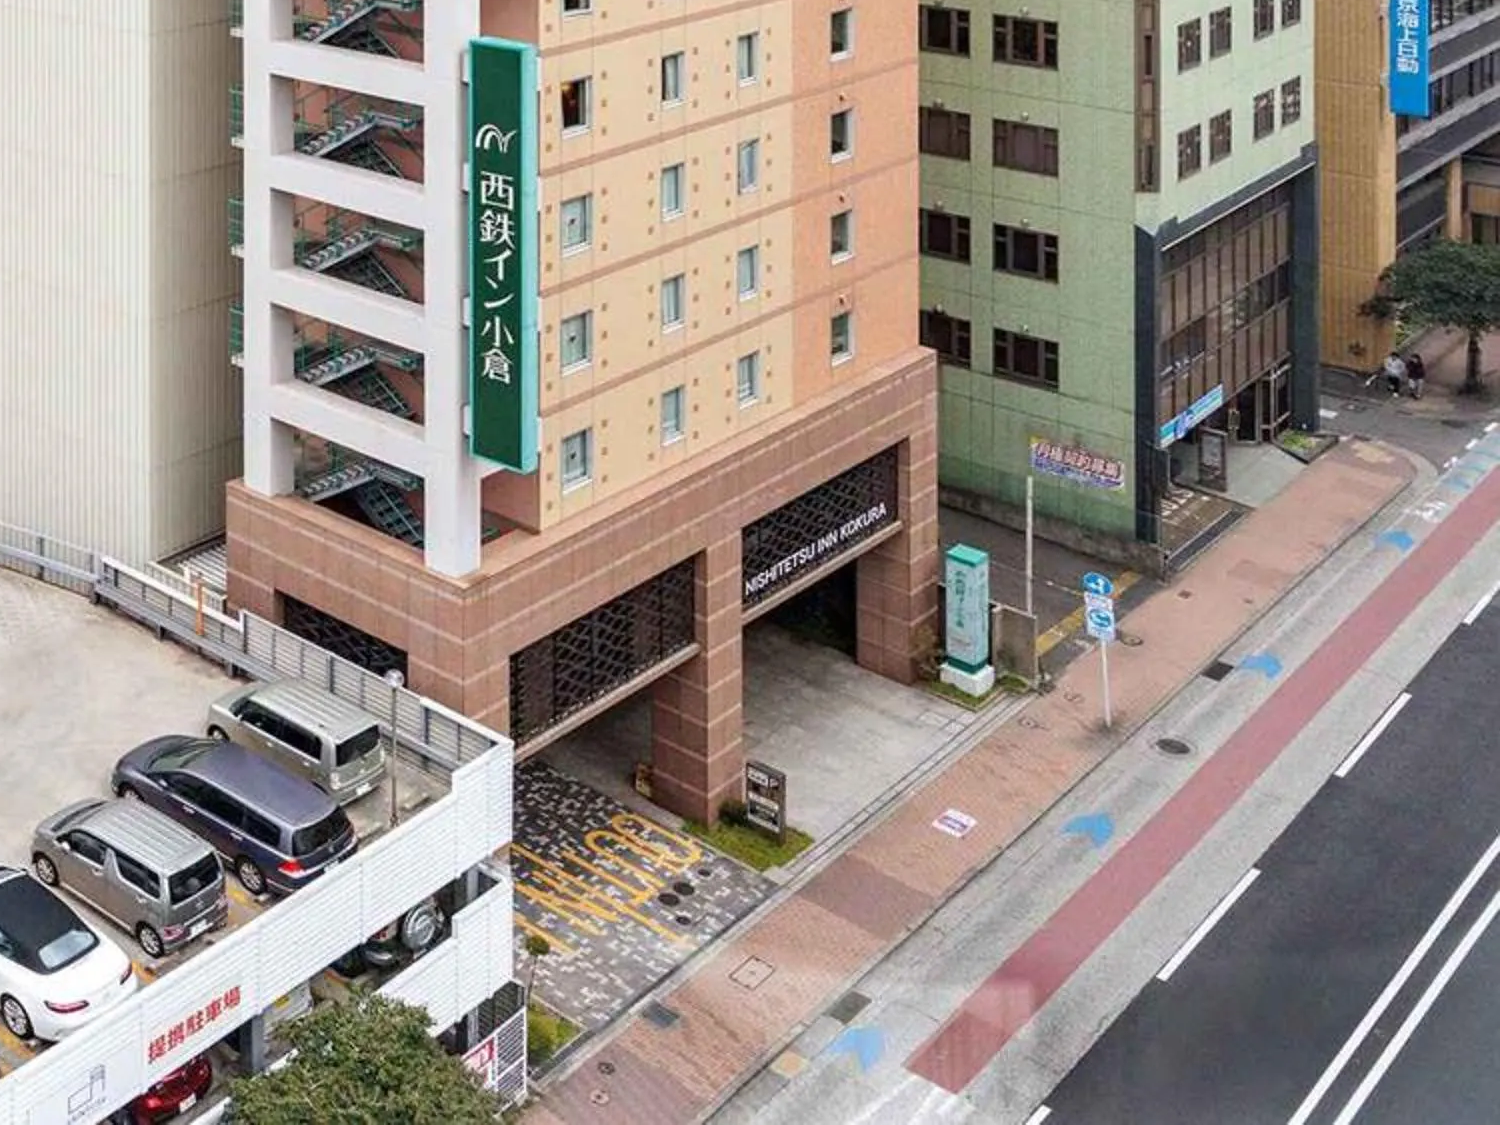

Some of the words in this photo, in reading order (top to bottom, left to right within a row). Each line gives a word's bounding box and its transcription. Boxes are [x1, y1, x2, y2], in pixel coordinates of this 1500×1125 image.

[479, 170, 516, 385] 西鉄イン小倉
[745, 543, 816, 595] NISHITETSU
[817, 531, 839, 555] INN
[840, 502, 887, 541] KOKURA
[148, 986, 241, 1064] 提携駐車場
